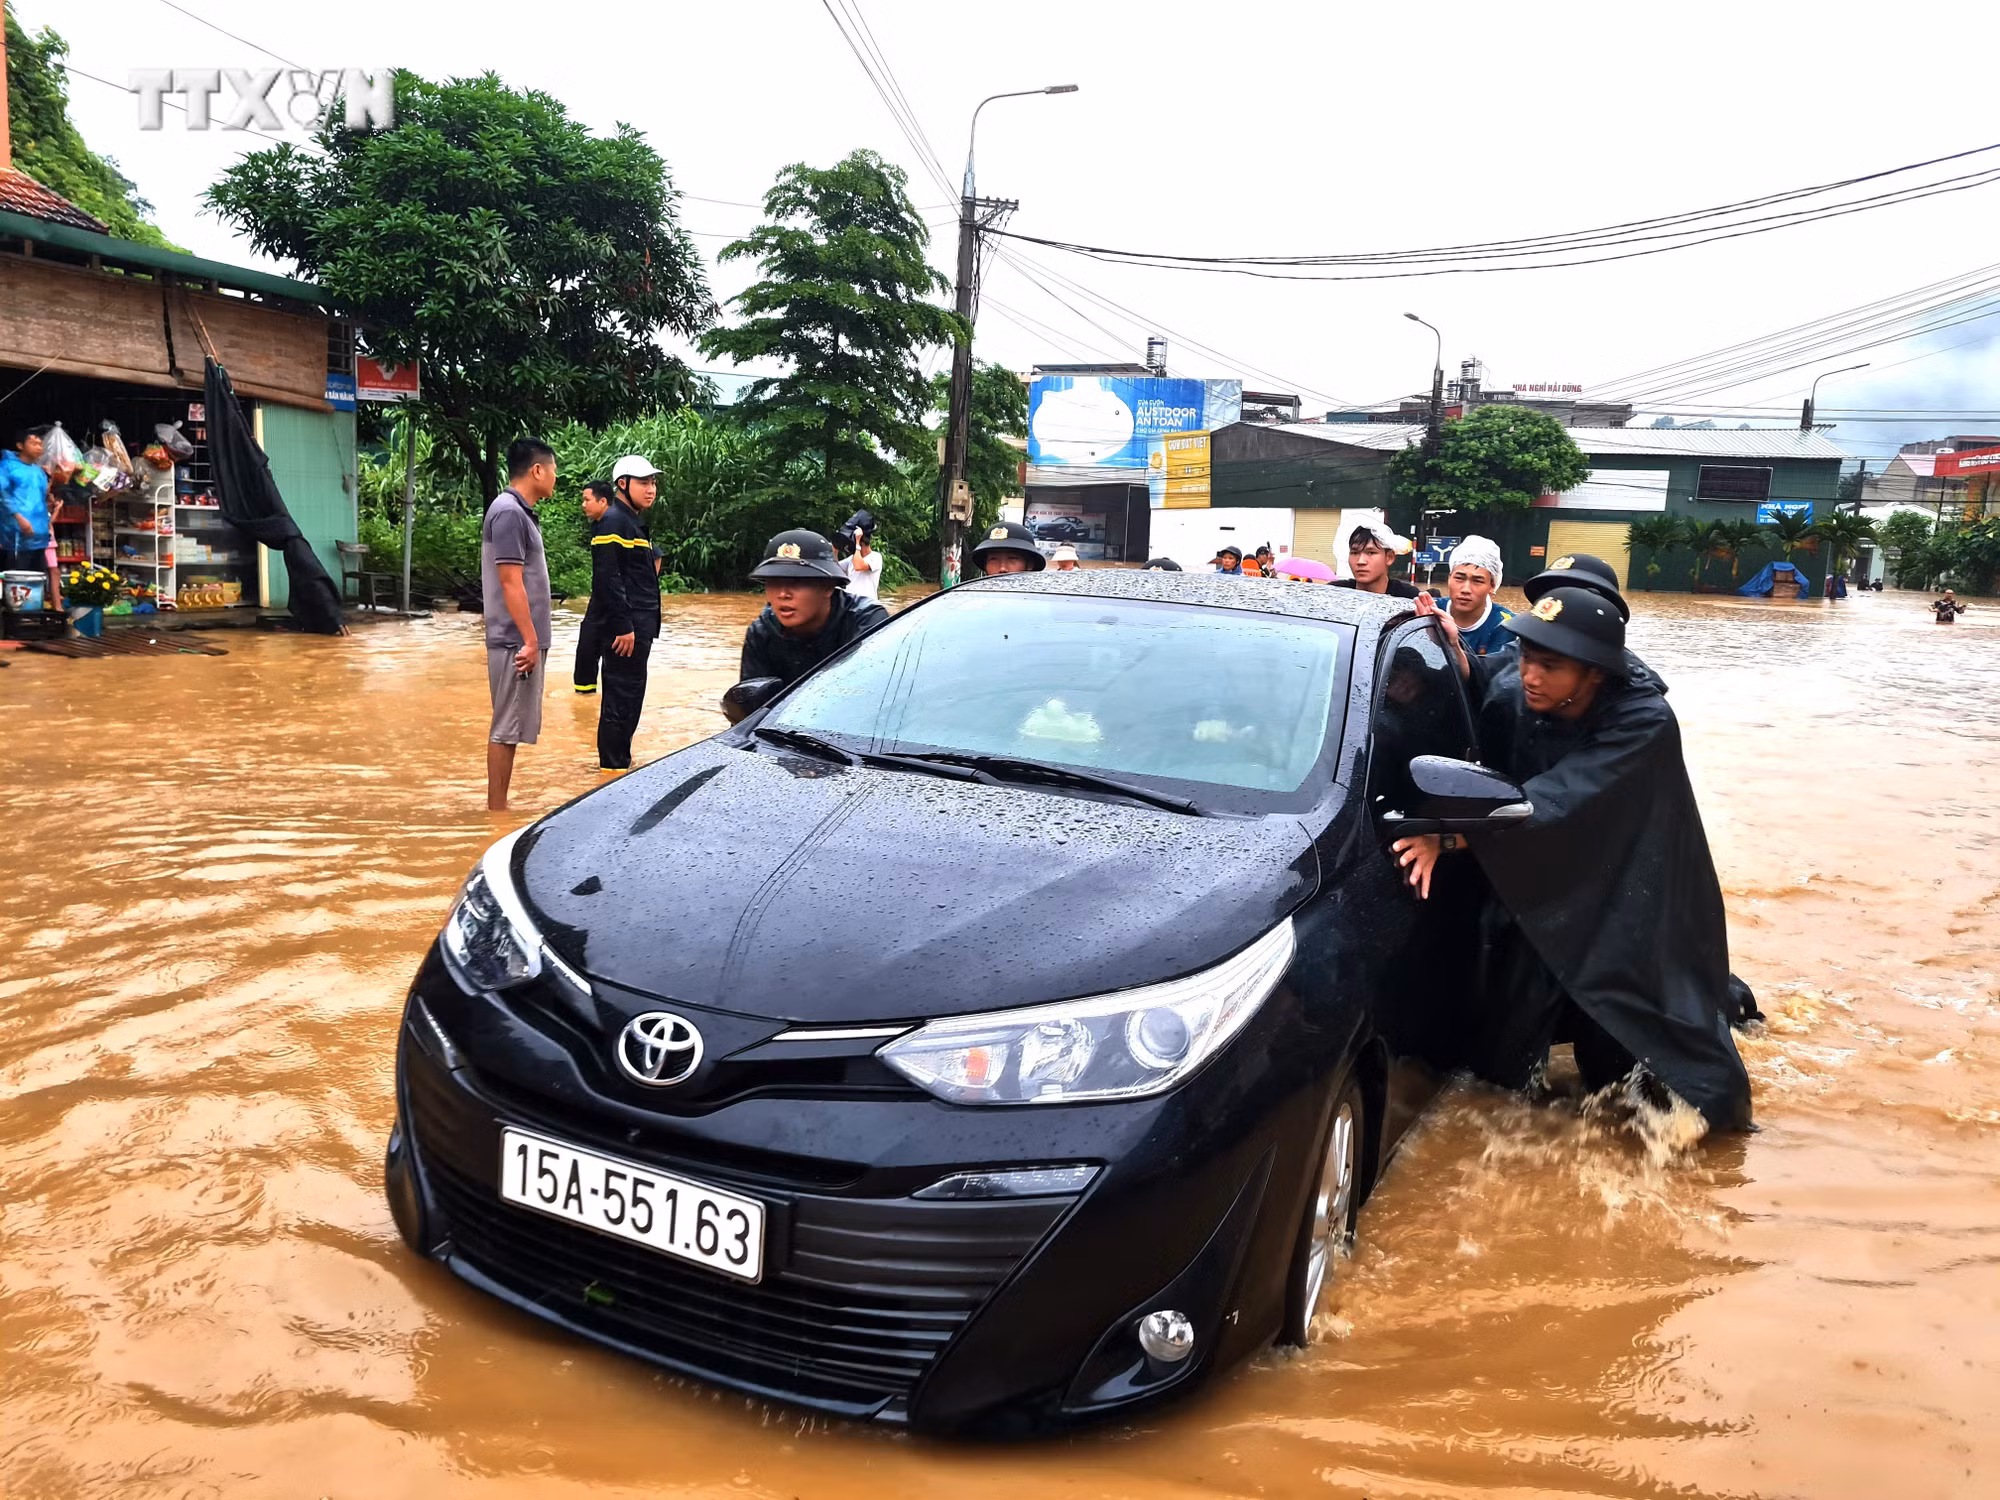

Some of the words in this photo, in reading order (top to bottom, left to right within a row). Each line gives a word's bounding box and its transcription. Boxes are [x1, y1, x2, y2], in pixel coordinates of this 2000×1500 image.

[1137, 407, 1197, 416] AUSTDOOR
[1136, 417, 1152, 425] AN
[517, 1143, 751, 1266] 15A-551.63
